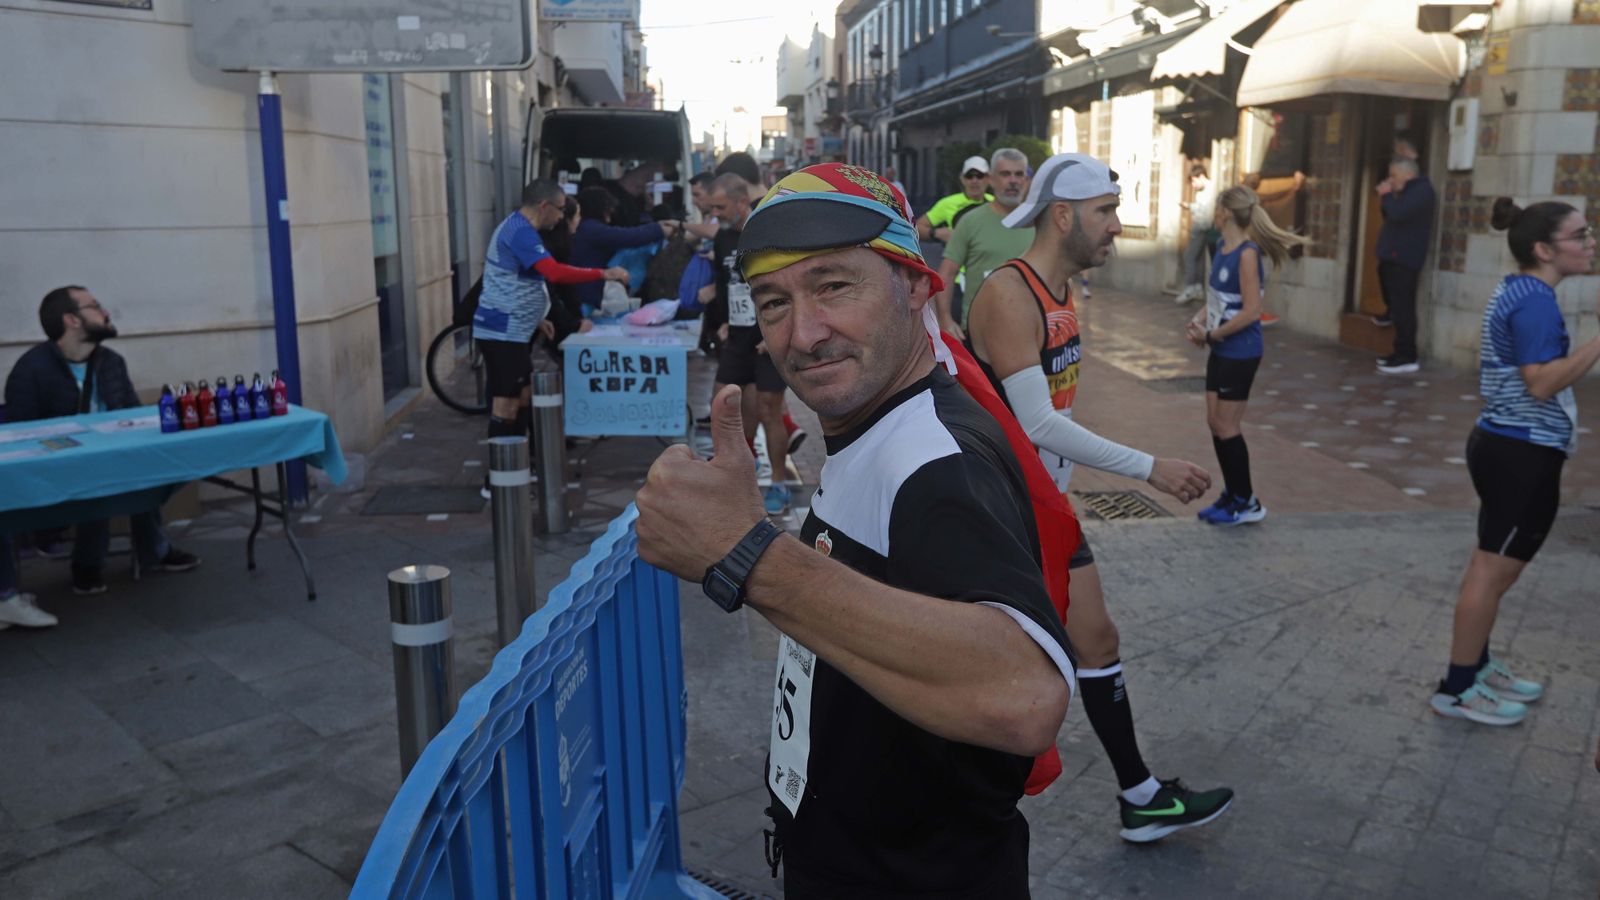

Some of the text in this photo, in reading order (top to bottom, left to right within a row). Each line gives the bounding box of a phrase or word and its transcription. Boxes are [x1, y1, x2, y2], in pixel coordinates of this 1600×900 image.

[578, 348, 670, 375] GUARDA
[589, 376, 658, 393] ROPA
[555, 658, 588, 721] DEPORTES
